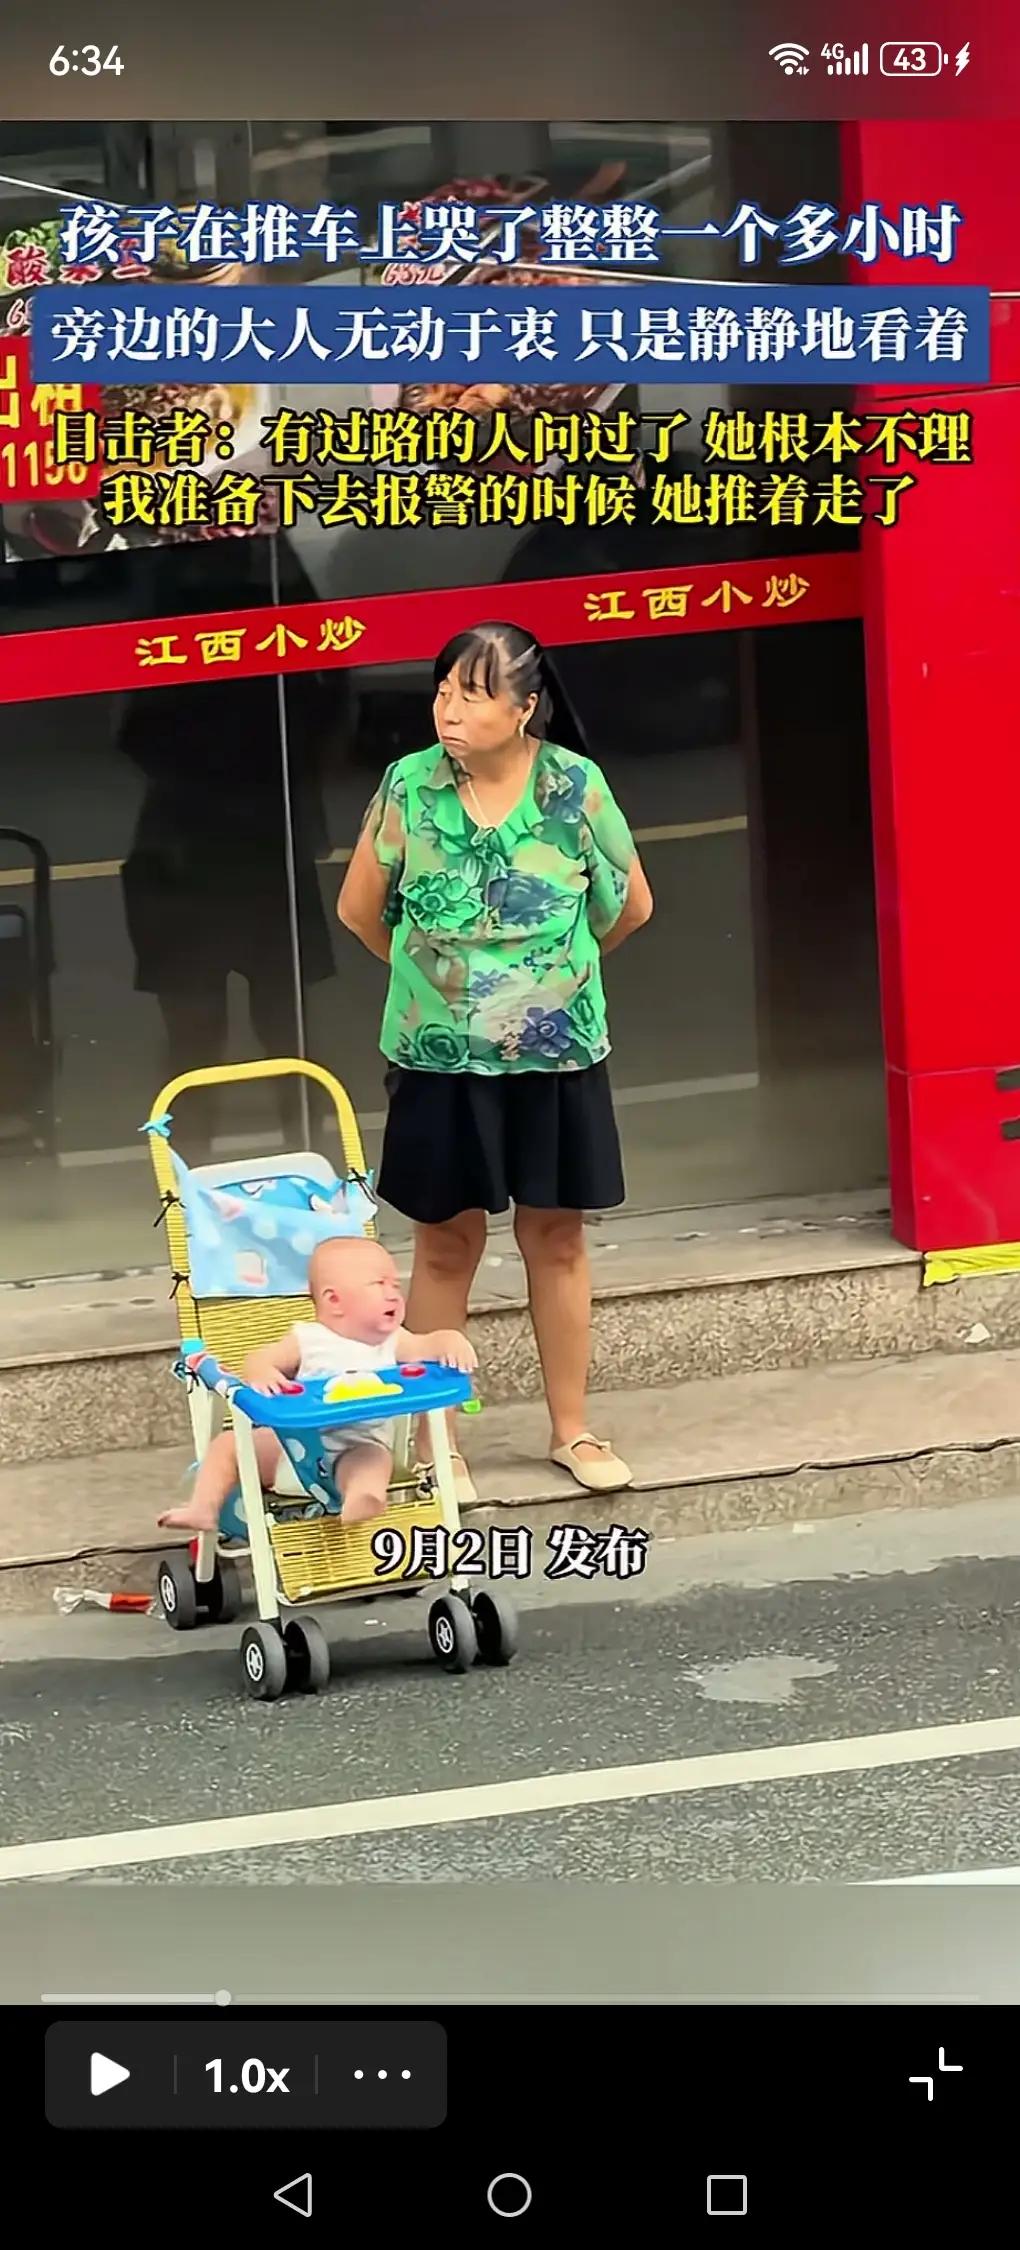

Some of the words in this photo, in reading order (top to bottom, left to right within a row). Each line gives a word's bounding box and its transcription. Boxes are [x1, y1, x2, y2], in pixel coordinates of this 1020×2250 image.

[583, 572, 811, 622] 江西小炒
[134, 615, 368, 668] 江西小炒
